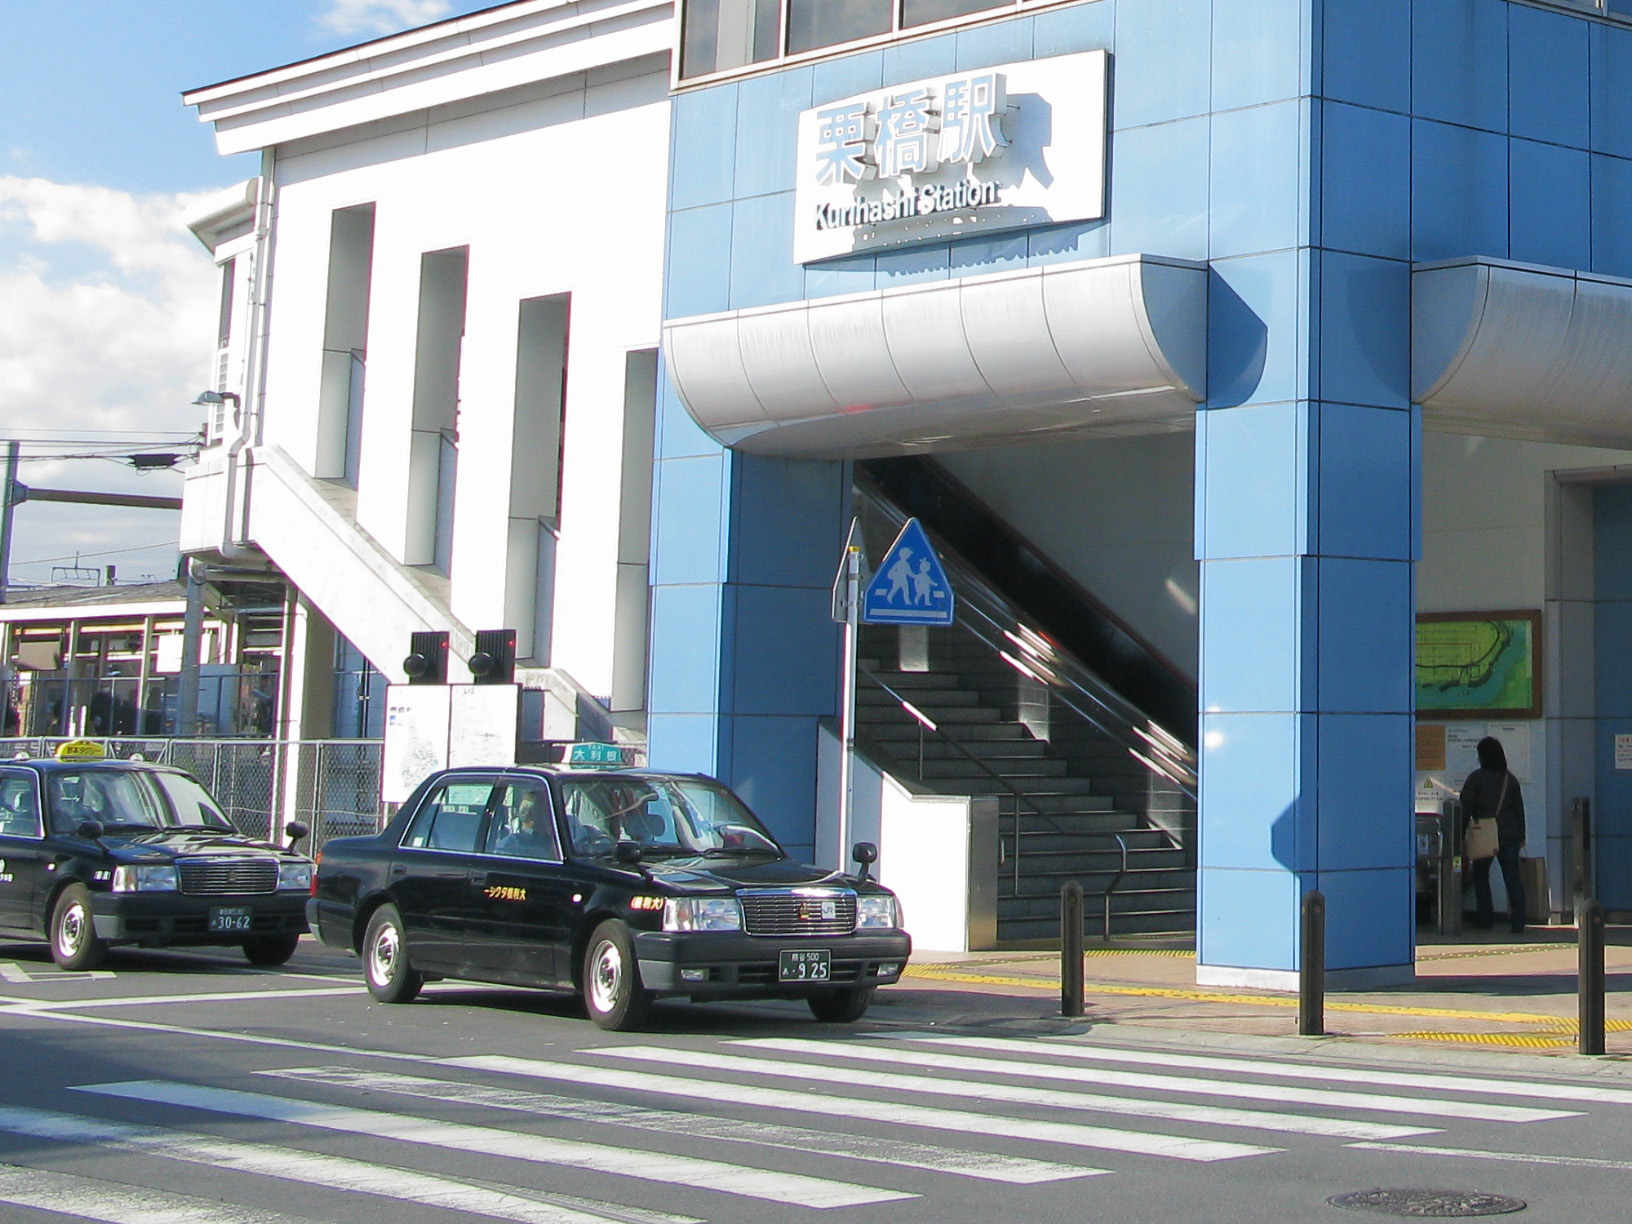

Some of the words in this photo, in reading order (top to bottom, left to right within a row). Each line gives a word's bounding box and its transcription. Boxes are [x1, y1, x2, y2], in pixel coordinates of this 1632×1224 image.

[815, 73, 1001, 186] 栗橋駅
[815, 187, 916, 231] Kurihashi
[918, 180, 997, 215] Station
[218, 915, 251, 928] 30-62
